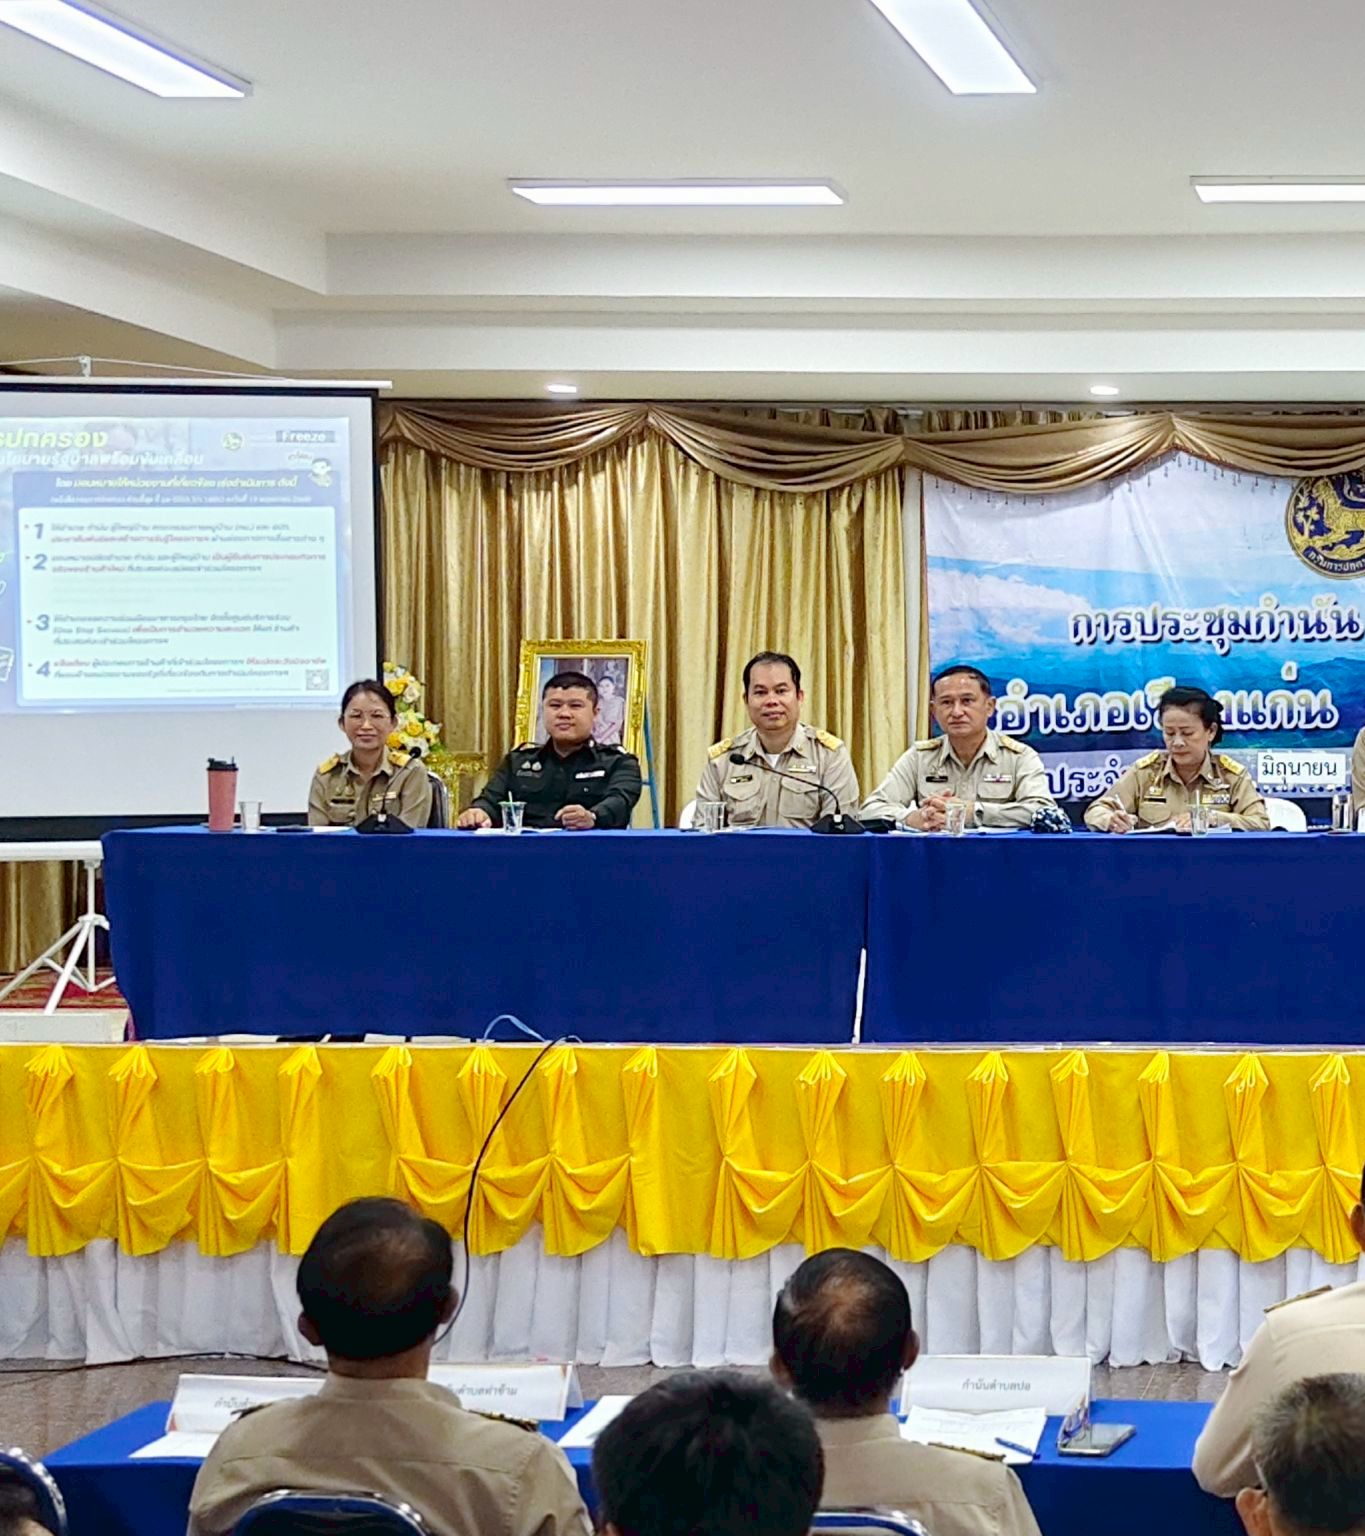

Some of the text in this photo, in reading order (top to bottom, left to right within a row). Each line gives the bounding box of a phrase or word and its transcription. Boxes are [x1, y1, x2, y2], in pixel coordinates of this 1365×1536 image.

[33, 523, 44, 539] 1
[32, 553, 48, 570] 2
[35, 614, 50, 631] 3
[1070, 594, 1365, 655] การประชุมกำนัน
[36, 660, 51, 678] 4
[1262, 755, 1338, 785] มิถุนายน
